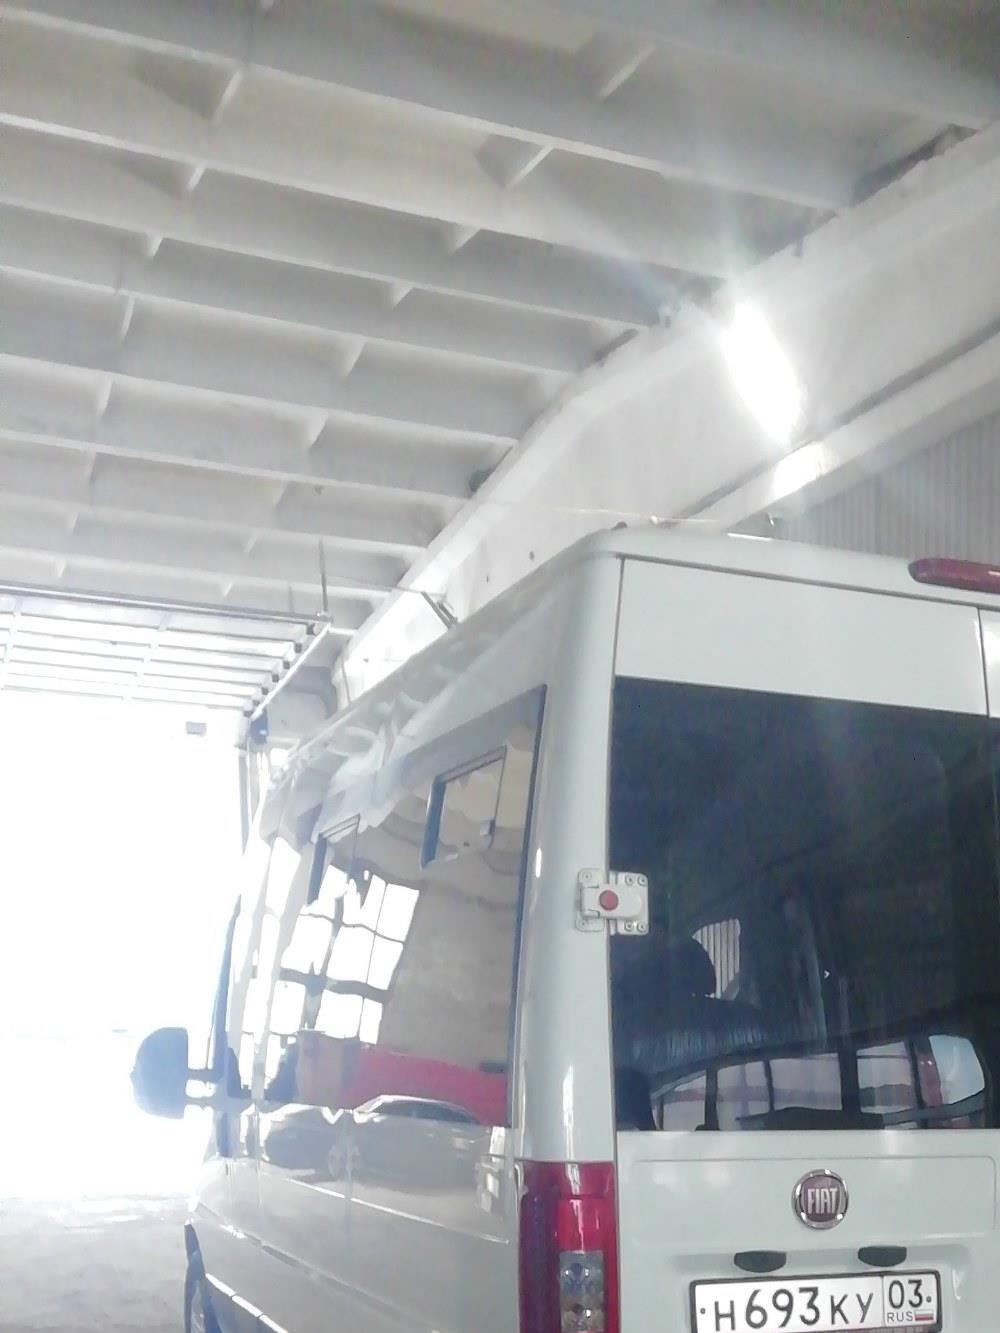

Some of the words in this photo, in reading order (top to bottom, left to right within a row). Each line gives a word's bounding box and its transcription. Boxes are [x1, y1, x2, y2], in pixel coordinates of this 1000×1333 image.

[807, 1187, 838, 1215] FIAT
[888, 1279, 924, 1308] 03
[886, 1312, 914, 1323] RUS
